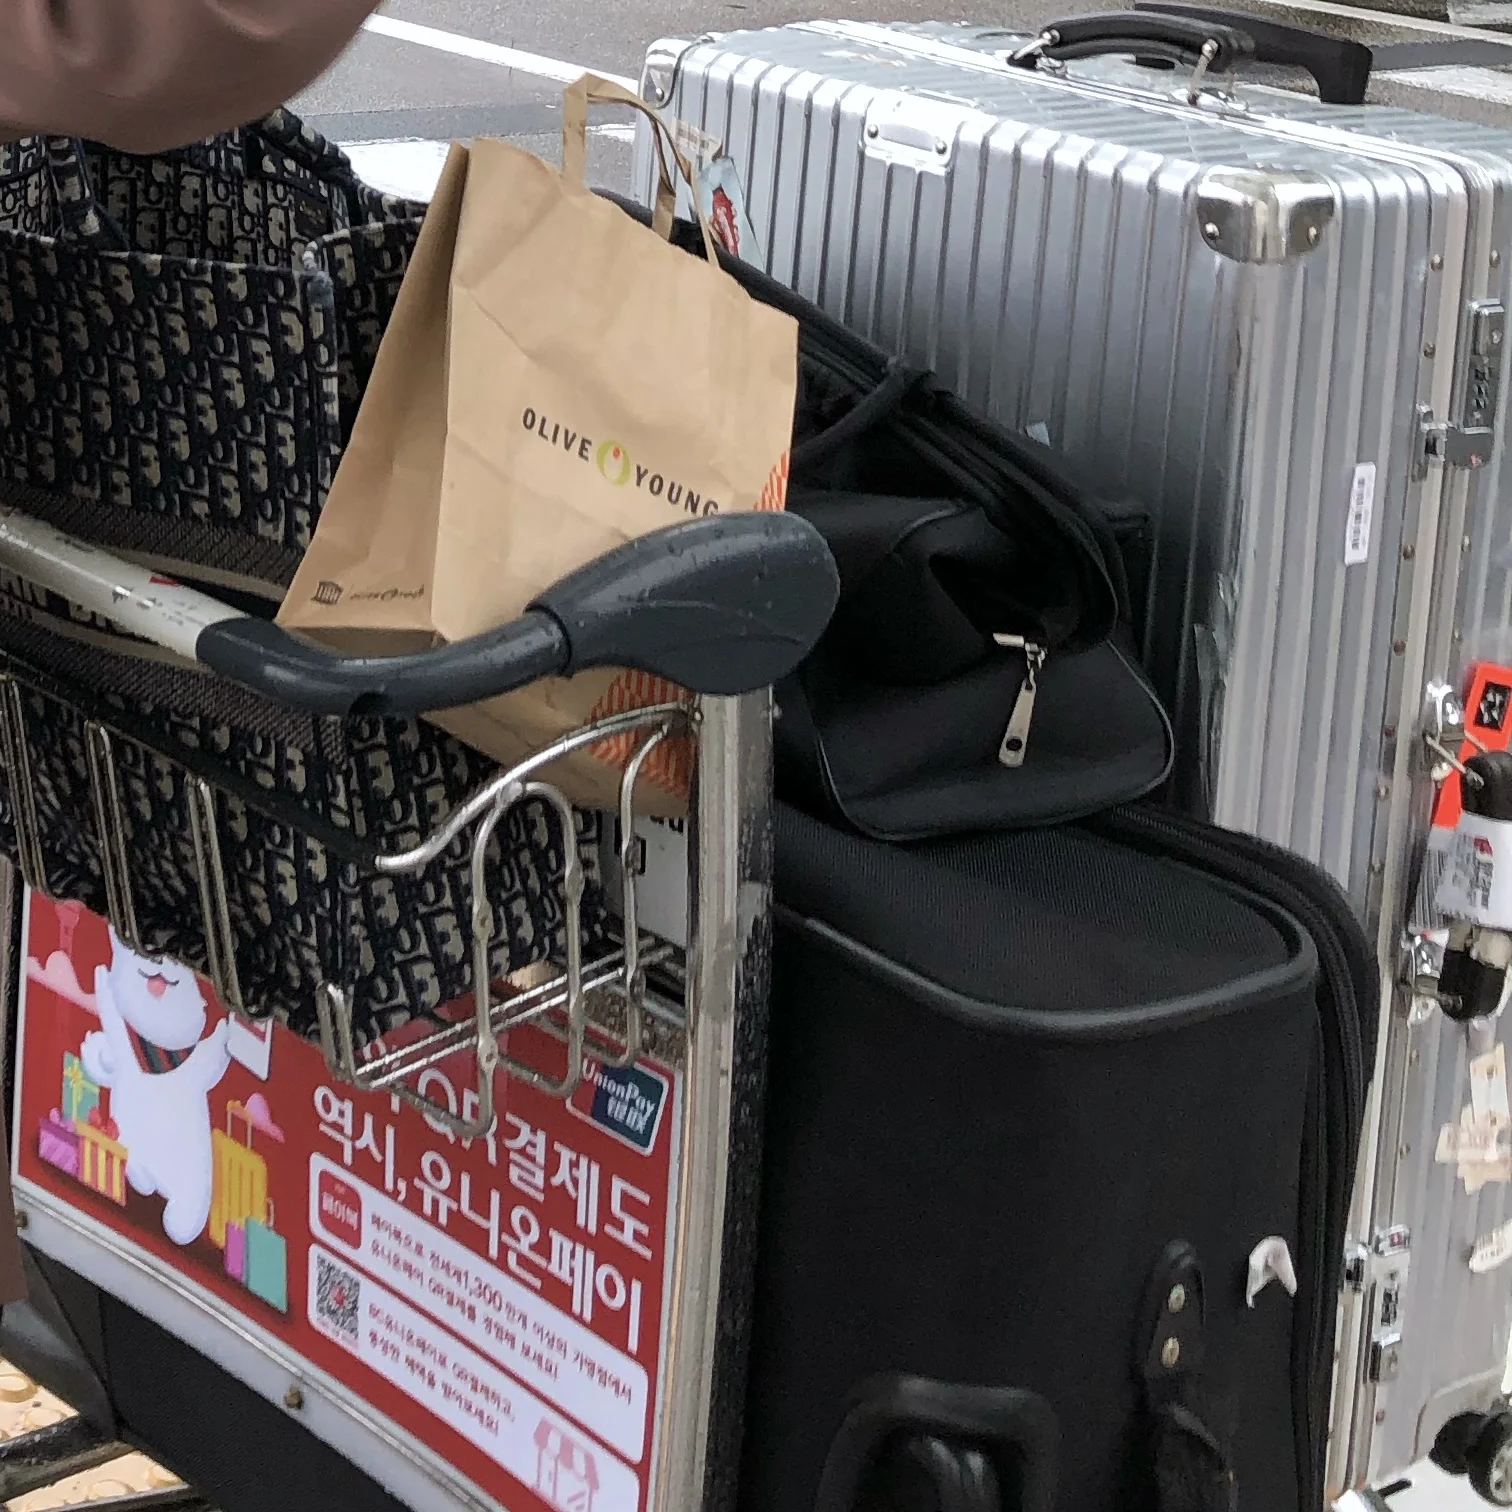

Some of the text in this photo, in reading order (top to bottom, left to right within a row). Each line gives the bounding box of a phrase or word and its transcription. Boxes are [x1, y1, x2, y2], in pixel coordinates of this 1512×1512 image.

[522, 407, 719, 517] OLIVE YOUNG
[582, 1057, 656, 1122] UnionPay
[413, 1150, 642, 1355] 유니온페이
